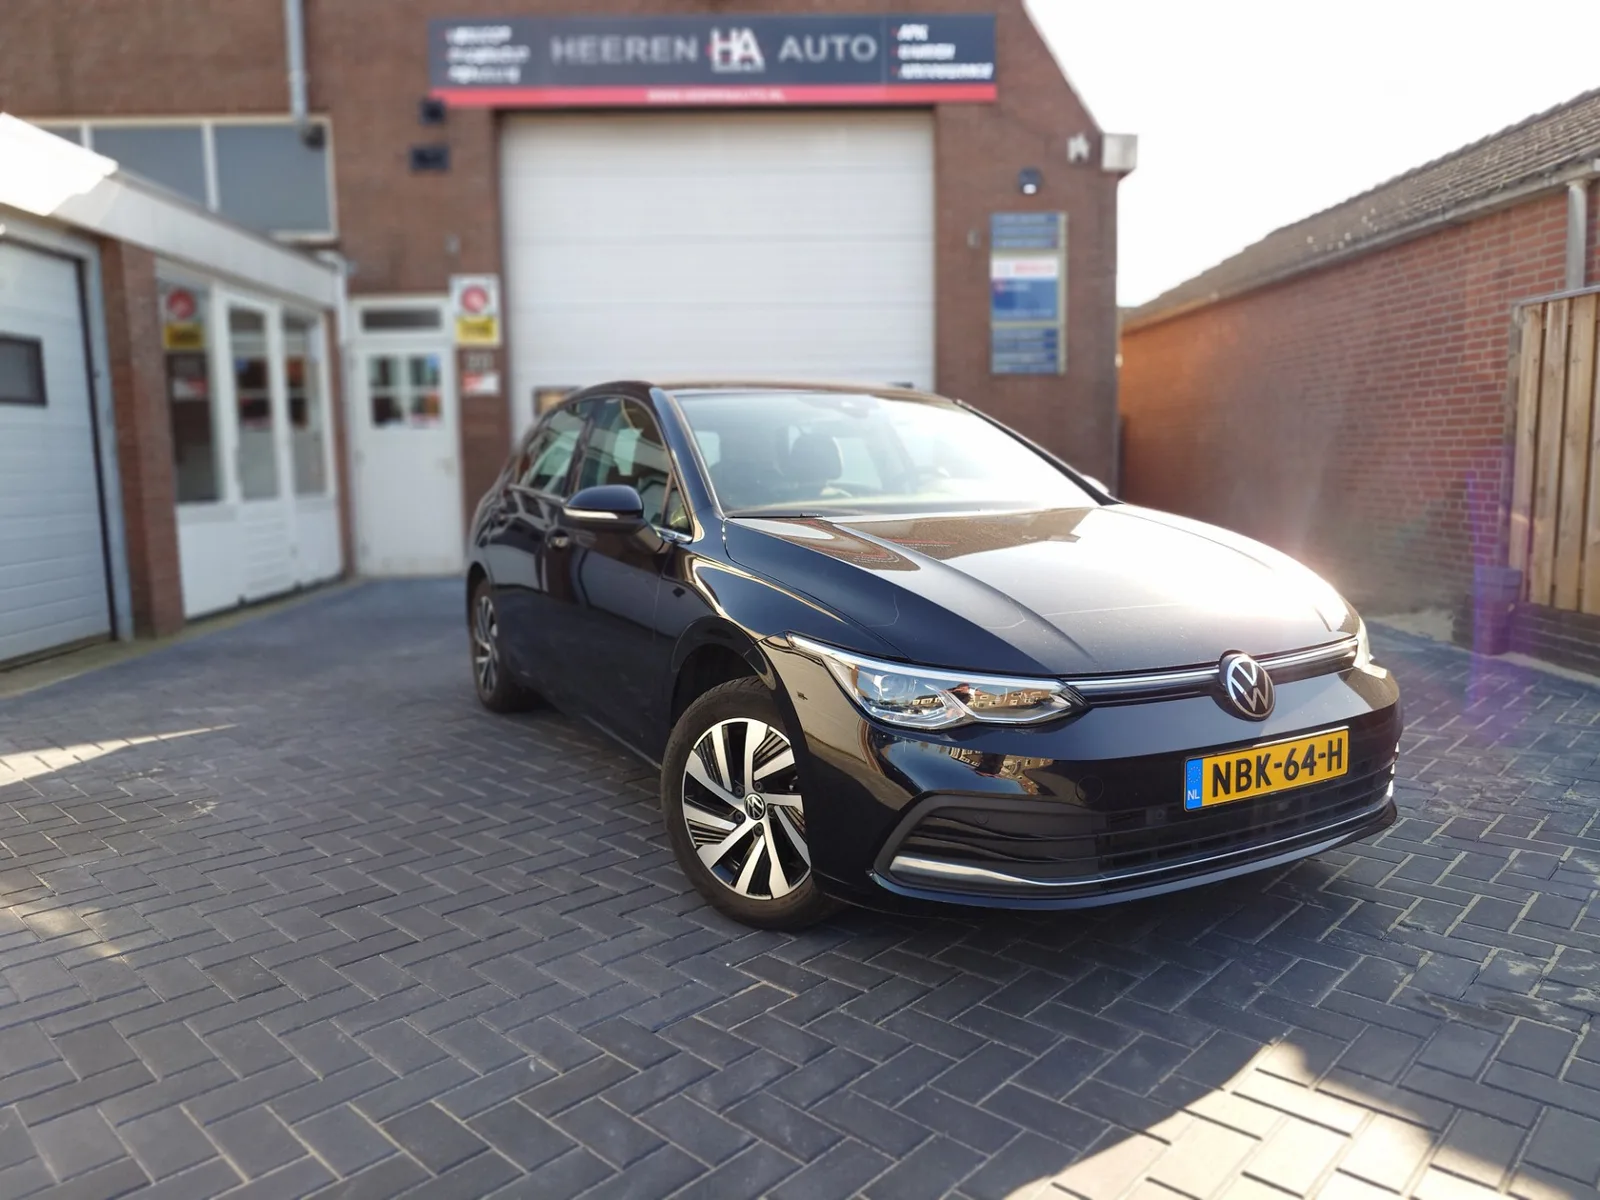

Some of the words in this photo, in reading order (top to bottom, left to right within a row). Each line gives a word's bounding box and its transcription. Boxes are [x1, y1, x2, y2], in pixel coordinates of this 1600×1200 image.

[551, 35, 698, 65] HEEREN
[711, 27, 764, 62] HA
[778, 34, 878, 62] AUTO
[1187, 789, 1201, 801] NL
[1211, 737, 1343, 798] NBK-64-H
